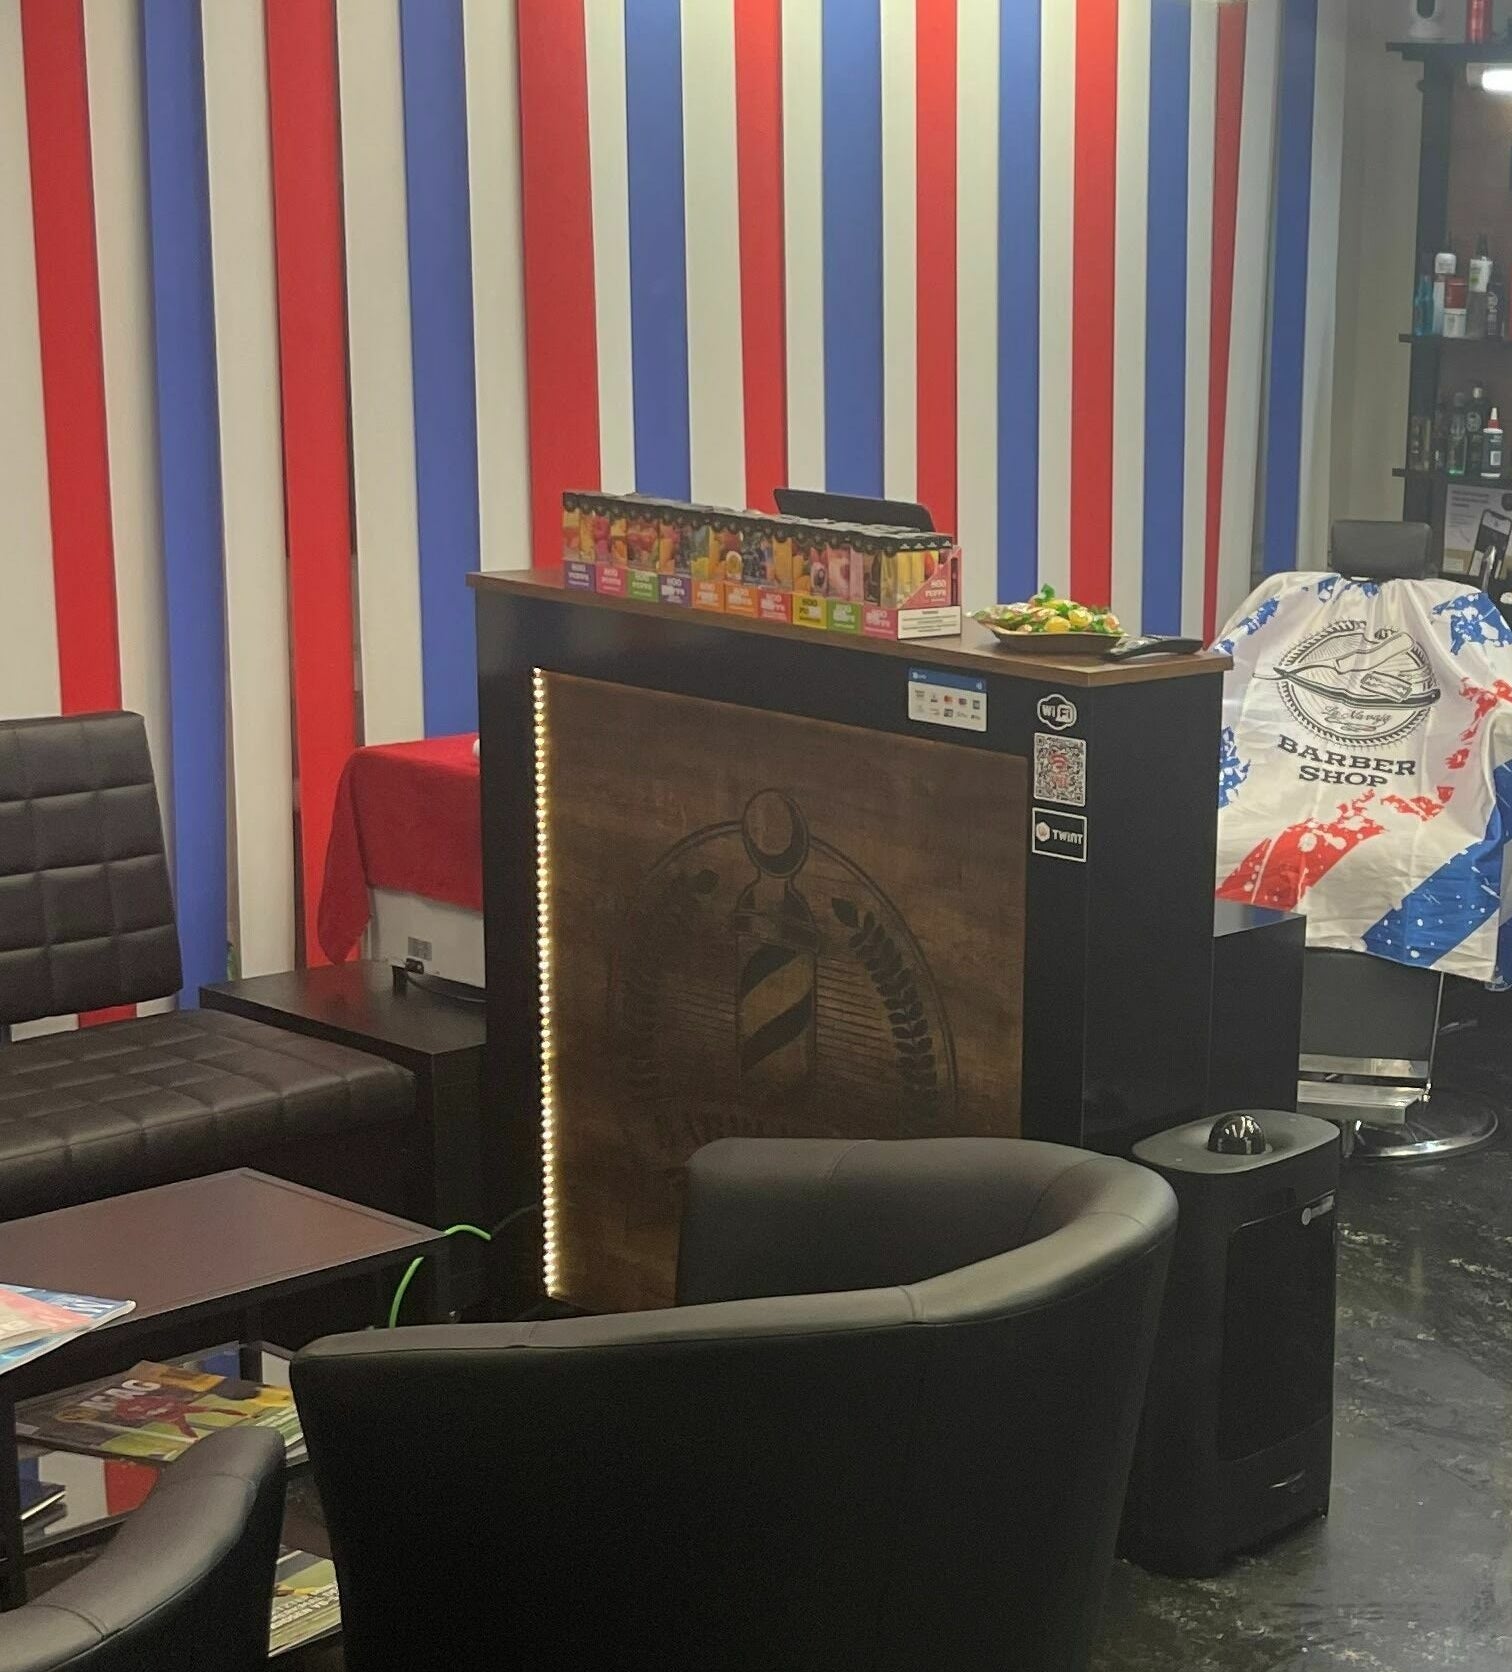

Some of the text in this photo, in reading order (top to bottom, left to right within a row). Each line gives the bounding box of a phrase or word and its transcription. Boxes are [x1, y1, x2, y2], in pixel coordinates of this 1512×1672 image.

[1277, 734, 1416, 776] BARBER
[1299, 764, 1388, 787] SHOP
[1052, 828, 1084, 845] TWINT
